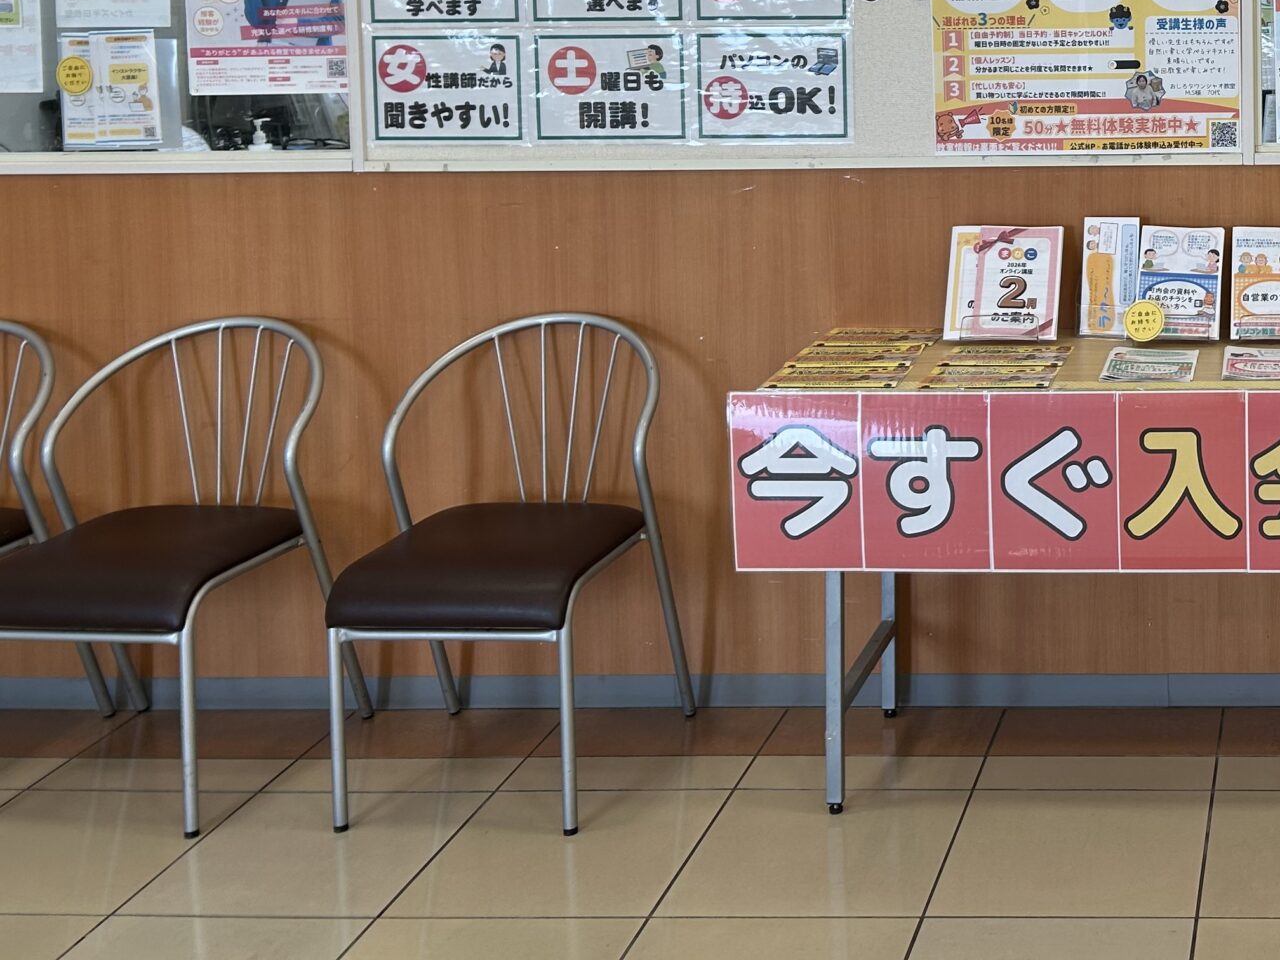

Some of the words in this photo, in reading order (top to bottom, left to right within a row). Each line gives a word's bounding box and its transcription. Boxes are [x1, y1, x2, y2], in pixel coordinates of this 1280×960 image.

[942, 12, 1026, 27] 選ばれる3つの理由
[1156, 17, 1227, 31] 受講生様の声
[949, 32, 959, 47] 1
[381, 46, 514, 89] 女性講師だから
[719, 53, 808, 70] パソコンの
[948, 56, 959, 71] 2
[949, 82, 960, 97] 3
[383, 101, 510, 130] 聞きやすい!
[578, 101, 650, 130] 開講!
[1019, 104, 1075, 115] 初めての方限定!!
[992, 126, 1011, 137] 限定
